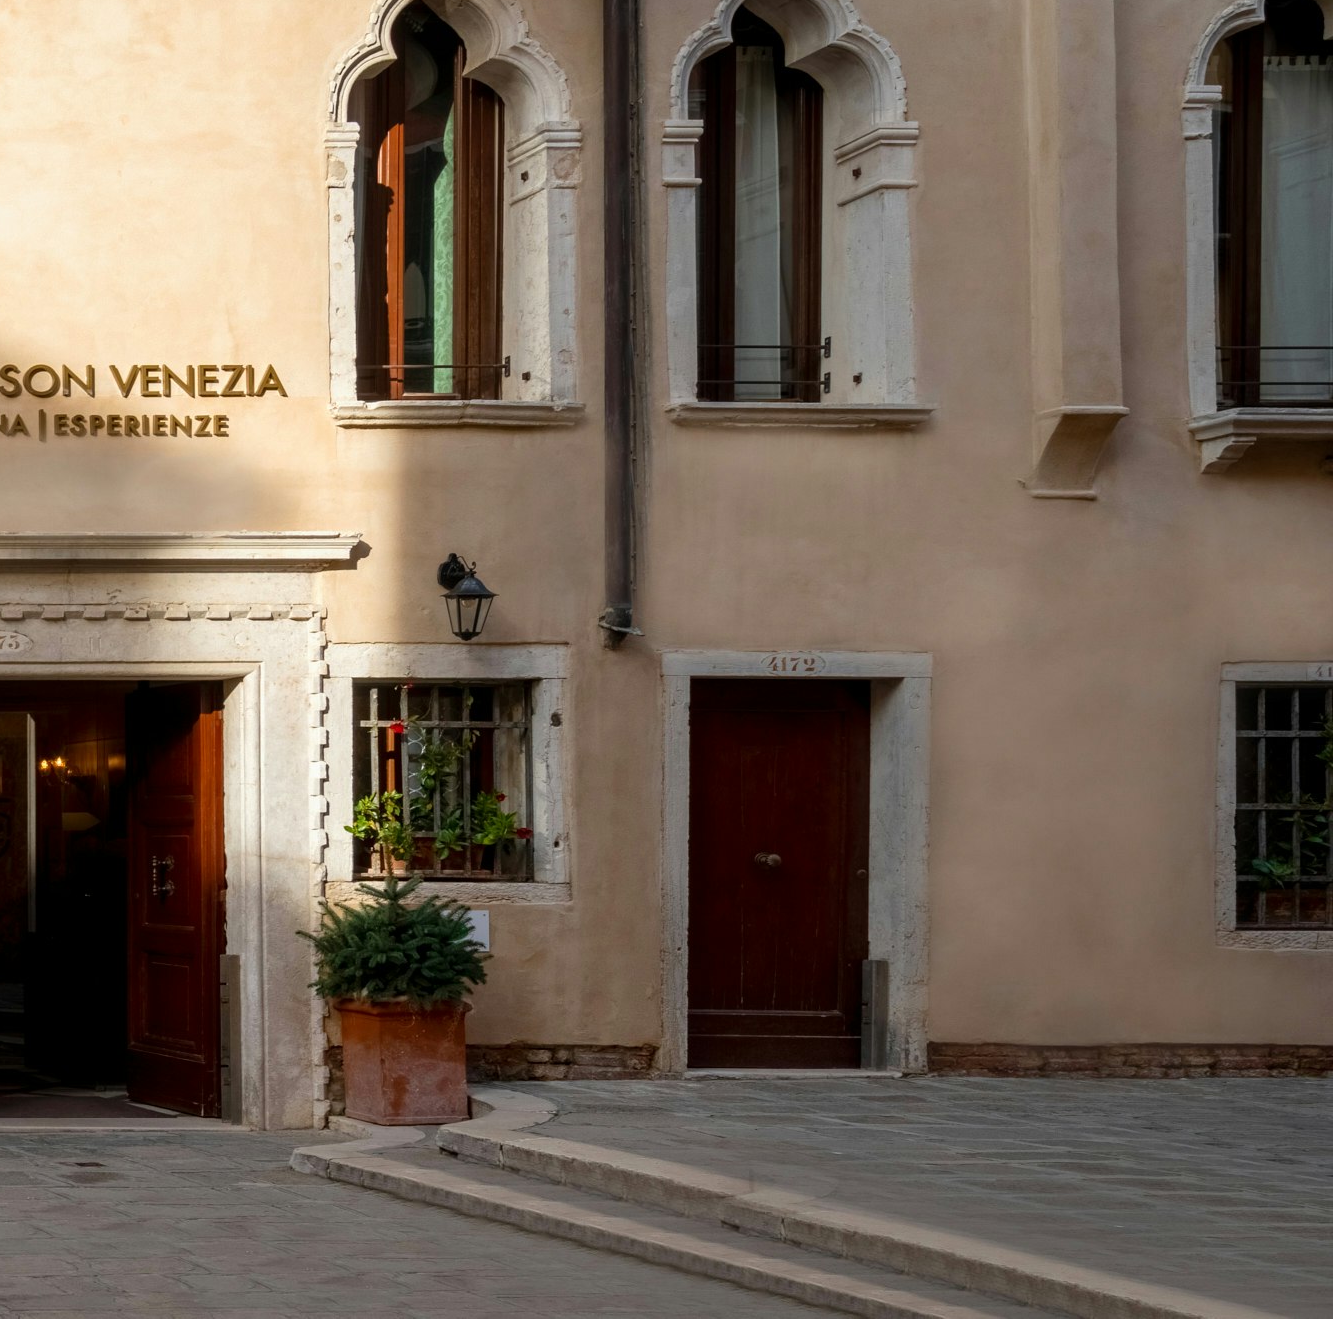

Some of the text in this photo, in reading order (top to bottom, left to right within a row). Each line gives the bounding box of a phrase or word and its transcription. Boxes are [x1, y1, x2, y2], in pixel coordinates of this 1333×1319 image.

[109, 364, 288, 398] VENEZIA
[53, 413, 230, 438] ESPERIENZE
[766, 656, 816, 672] 4172
